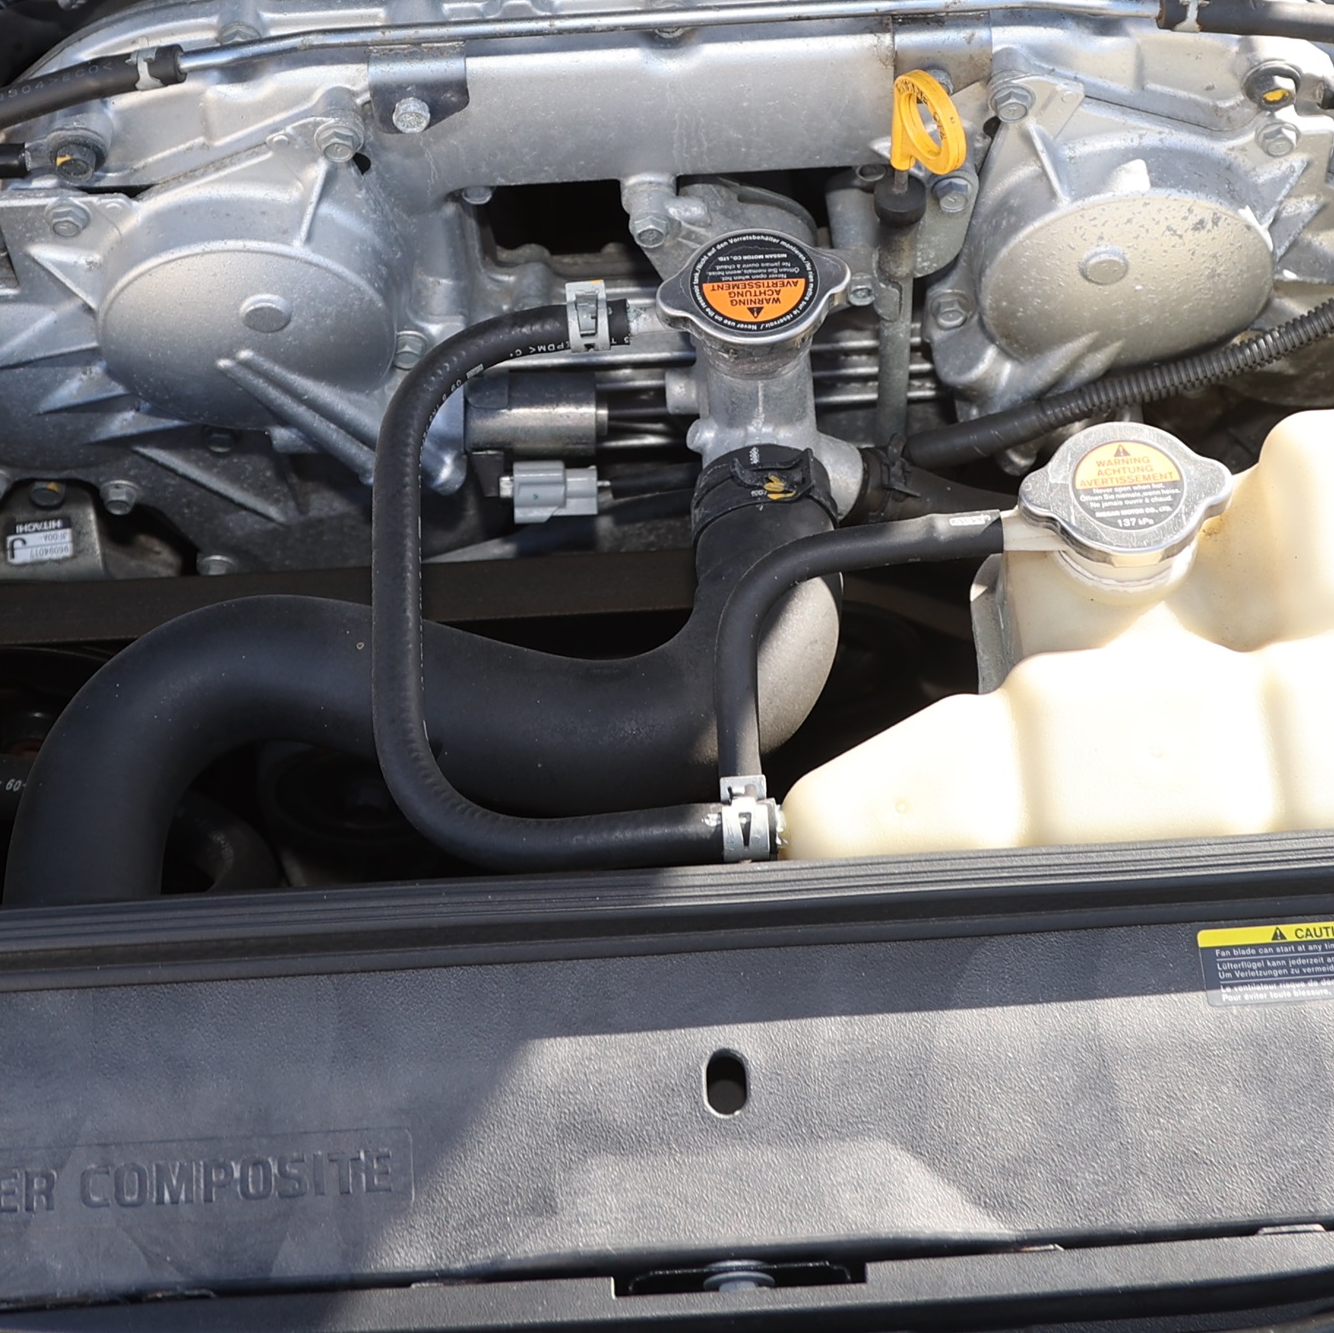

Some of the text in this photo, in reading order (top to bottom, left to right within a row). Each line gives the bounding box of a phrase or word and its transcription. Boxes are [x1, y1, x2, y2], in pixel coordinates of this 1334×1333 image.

[710, 280, 799, 291] AVERTISSEMENT
[728, 289, 781, 298] ACHTUNG
[730, 298, 781, 306] WARNING
[703, 306, 716, 316] the
[722, 318, 736, 327] use
[1096, 456, 1150, 467] WARNING
[1097, 465, 1153, 476] ACHTUNG
[1079, 472, 1174, 487] AVERTISSEMENT
[15, 518, 61, 534] HITACHI
[1117, 516, 1154, 527] 137 kPa
[8, 536, 28, 560] J
[1215, 949, 1231, 957] Fan
[1233, 947, 1256, 956] blade
[1258, 947, 1274, 955] can
[1276, 944, 1295, 953] start
[1297, 944, 1306, 952] at
[1308, 944, 1322, 953] any
[1217, 960, 1265, 972] Lüfterflügel
[1267, 959, 1286, 967] kann
[1288, 956, 1324, 967] jederzeit
[1218, 971, 1232, 979] Um
[1235, 967, 1288, 980] Verletzungen
[78, 1148, 393, 1209] COMPOSITE
